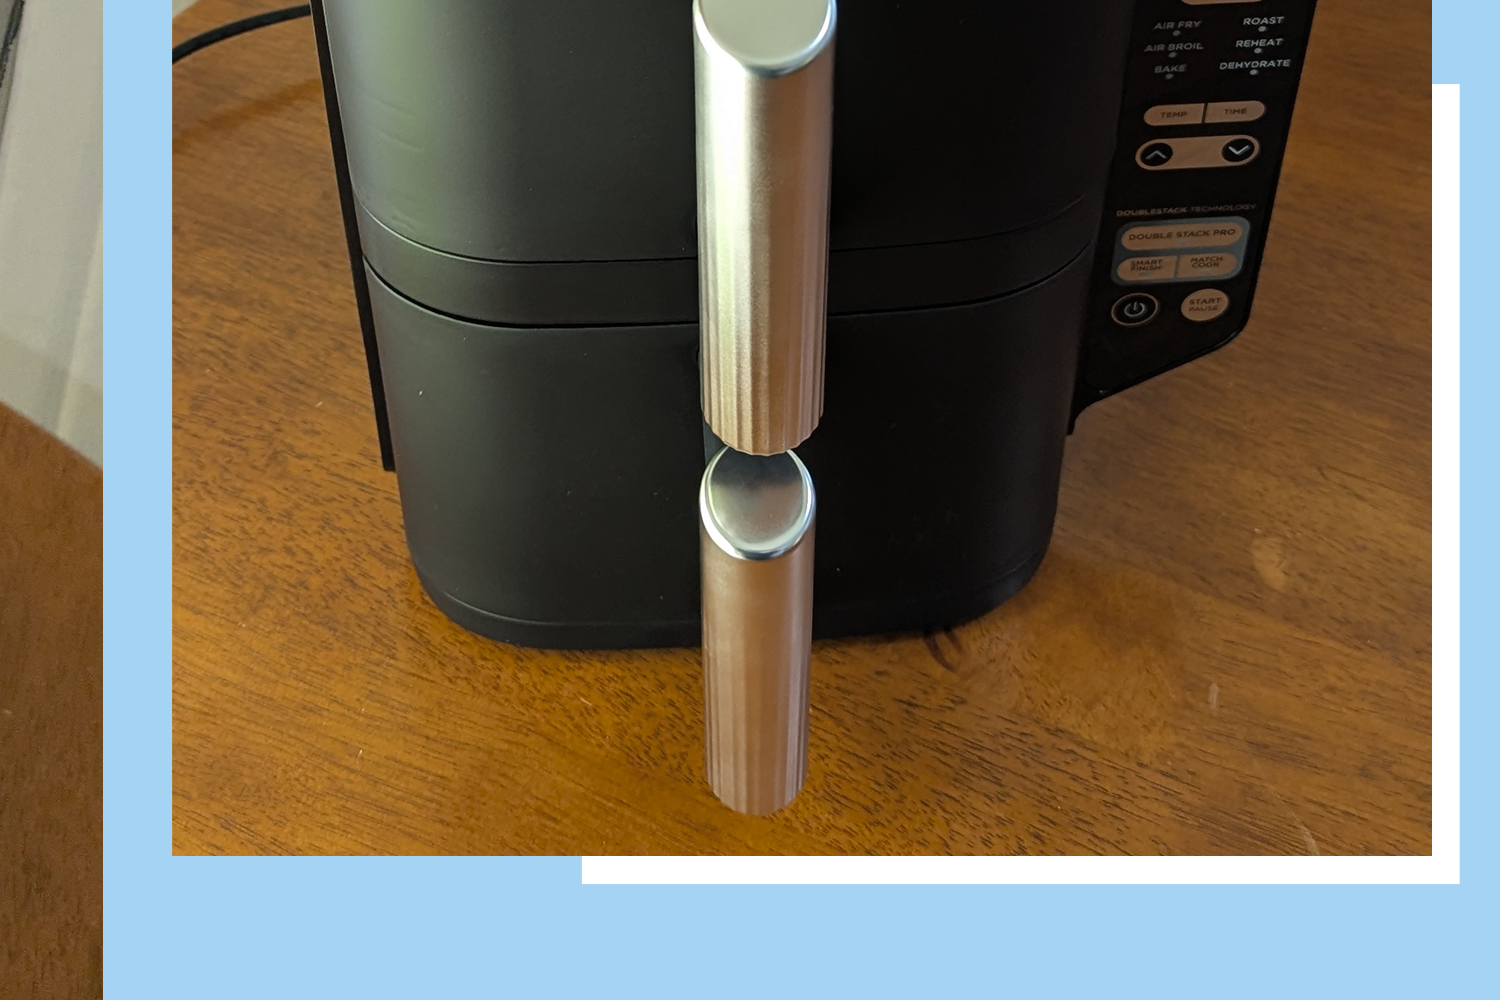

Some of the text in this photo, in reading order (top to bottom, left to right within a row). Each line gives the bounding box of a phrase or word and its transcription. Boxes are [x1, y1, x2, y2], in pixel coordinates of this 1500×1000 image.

[1152, 20, 1202, 30] AIR FRY
[1243, 16, 1285, 25] ROAST
[1144, 42, 1204, 52] AIR BROIL
[1235, 38, 1284, 47] REHEAT
[1154, 64, 1187, 73] BAKE
[1219, 58, 1292, 70] DEHYDRATE
[1160, 110, 1188, 119] TEMP
[1224, 107, 1248, 115] TIME
[1128, 228, 1236, 241] DOUBLE STACK PRO
[1189, 296, 1222, 305] START
[1188, 304, 1219, 312] PAUSE
